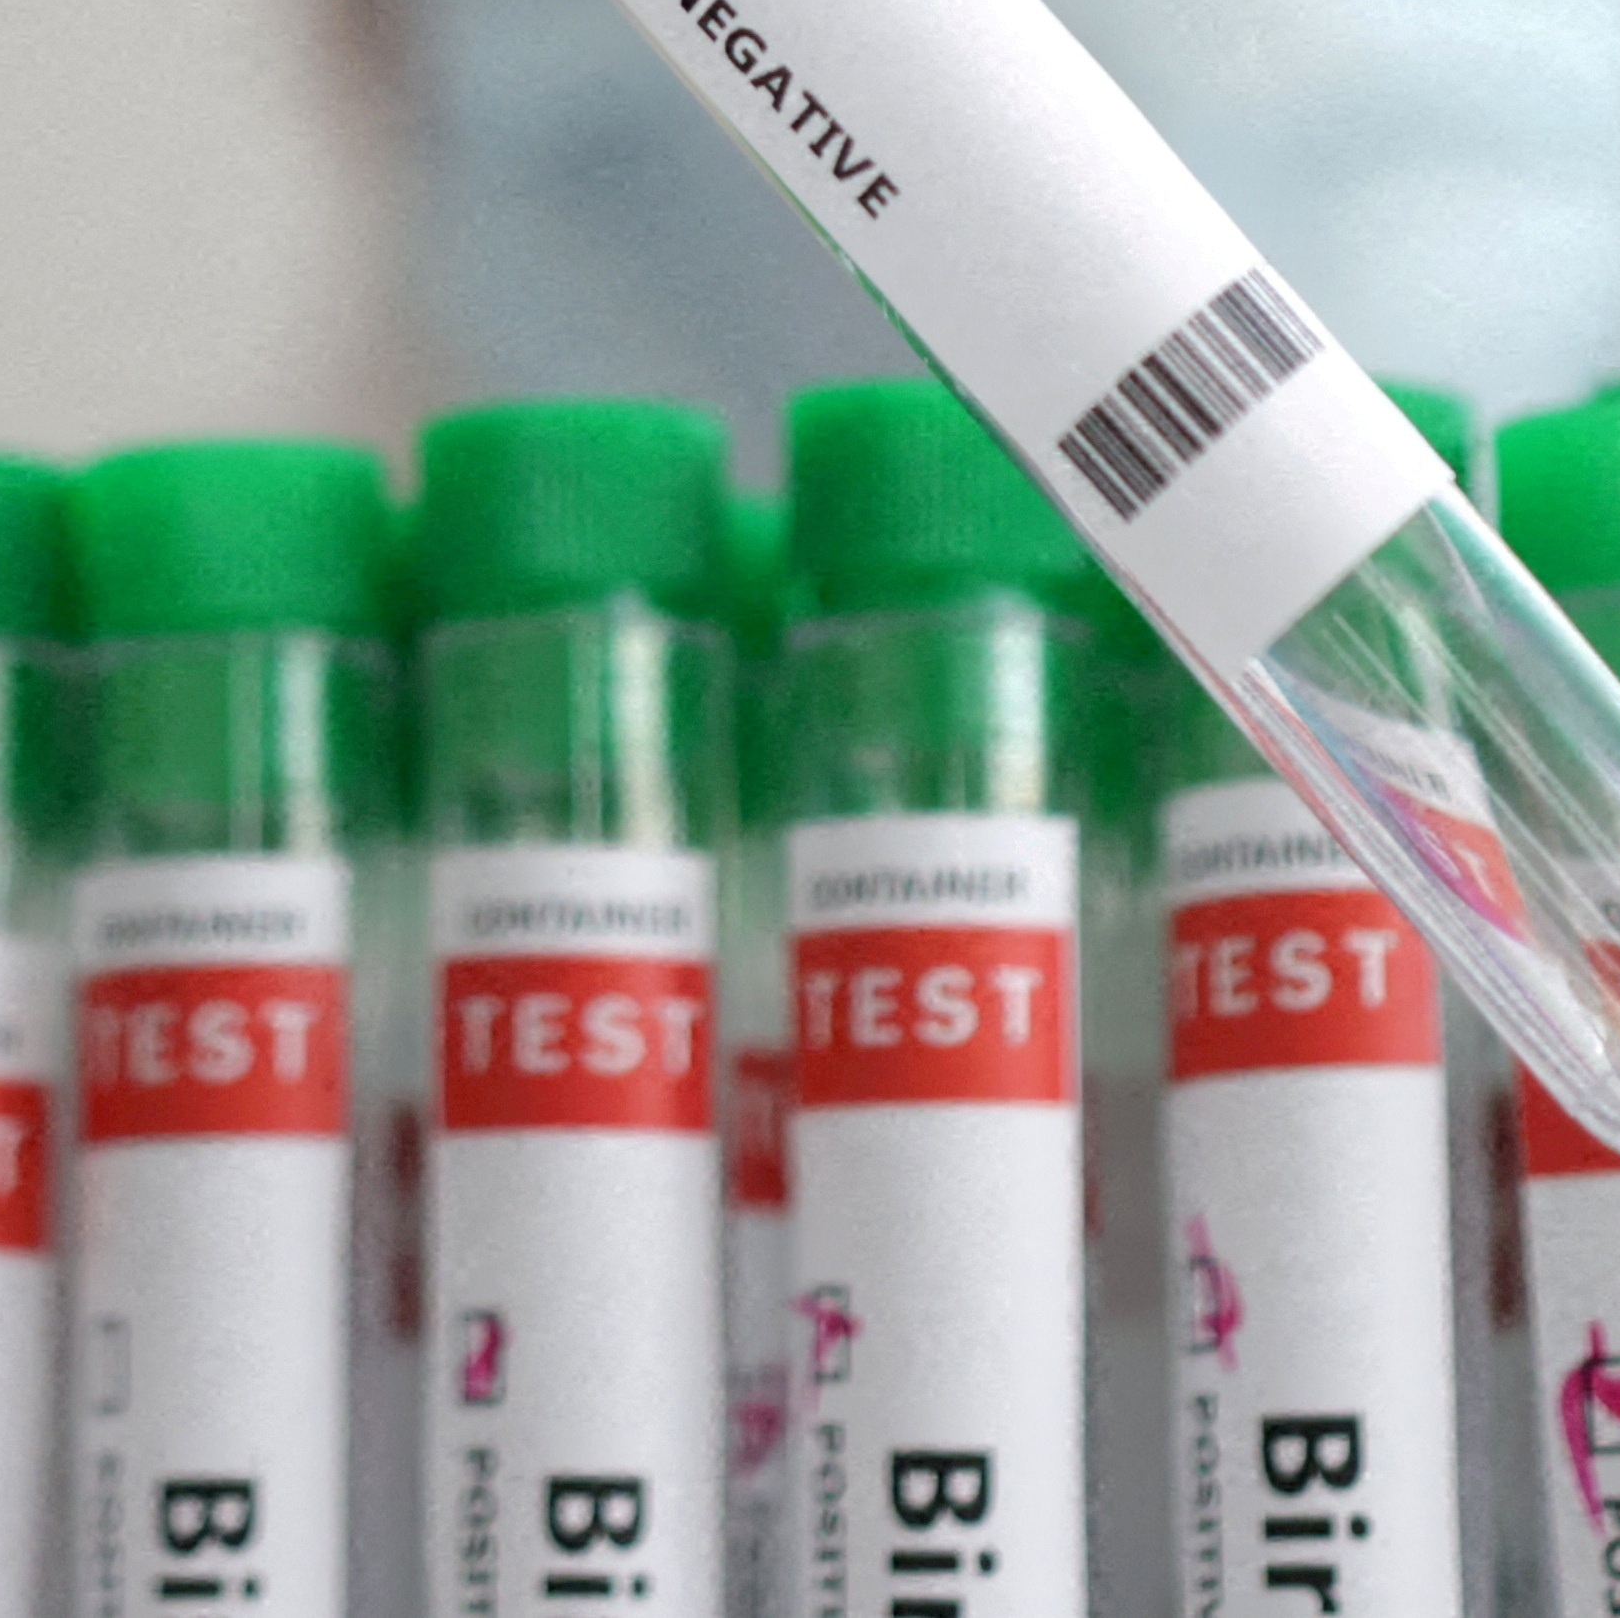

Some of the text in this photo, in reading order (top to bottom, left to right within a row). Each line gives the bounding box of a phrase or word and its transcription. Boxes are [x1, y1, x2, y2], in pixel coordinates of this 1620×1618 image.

[803, 963, 1044, 1049] TEST
[1173, 929, 1398, 1019] TEST
[455, 990, 705, 1076] TEST
[158, 1478, 261, 1599] Bi
[545, 1476, 648, 1596] Bi
[1262, 1415, 1371, 1614] Bir
